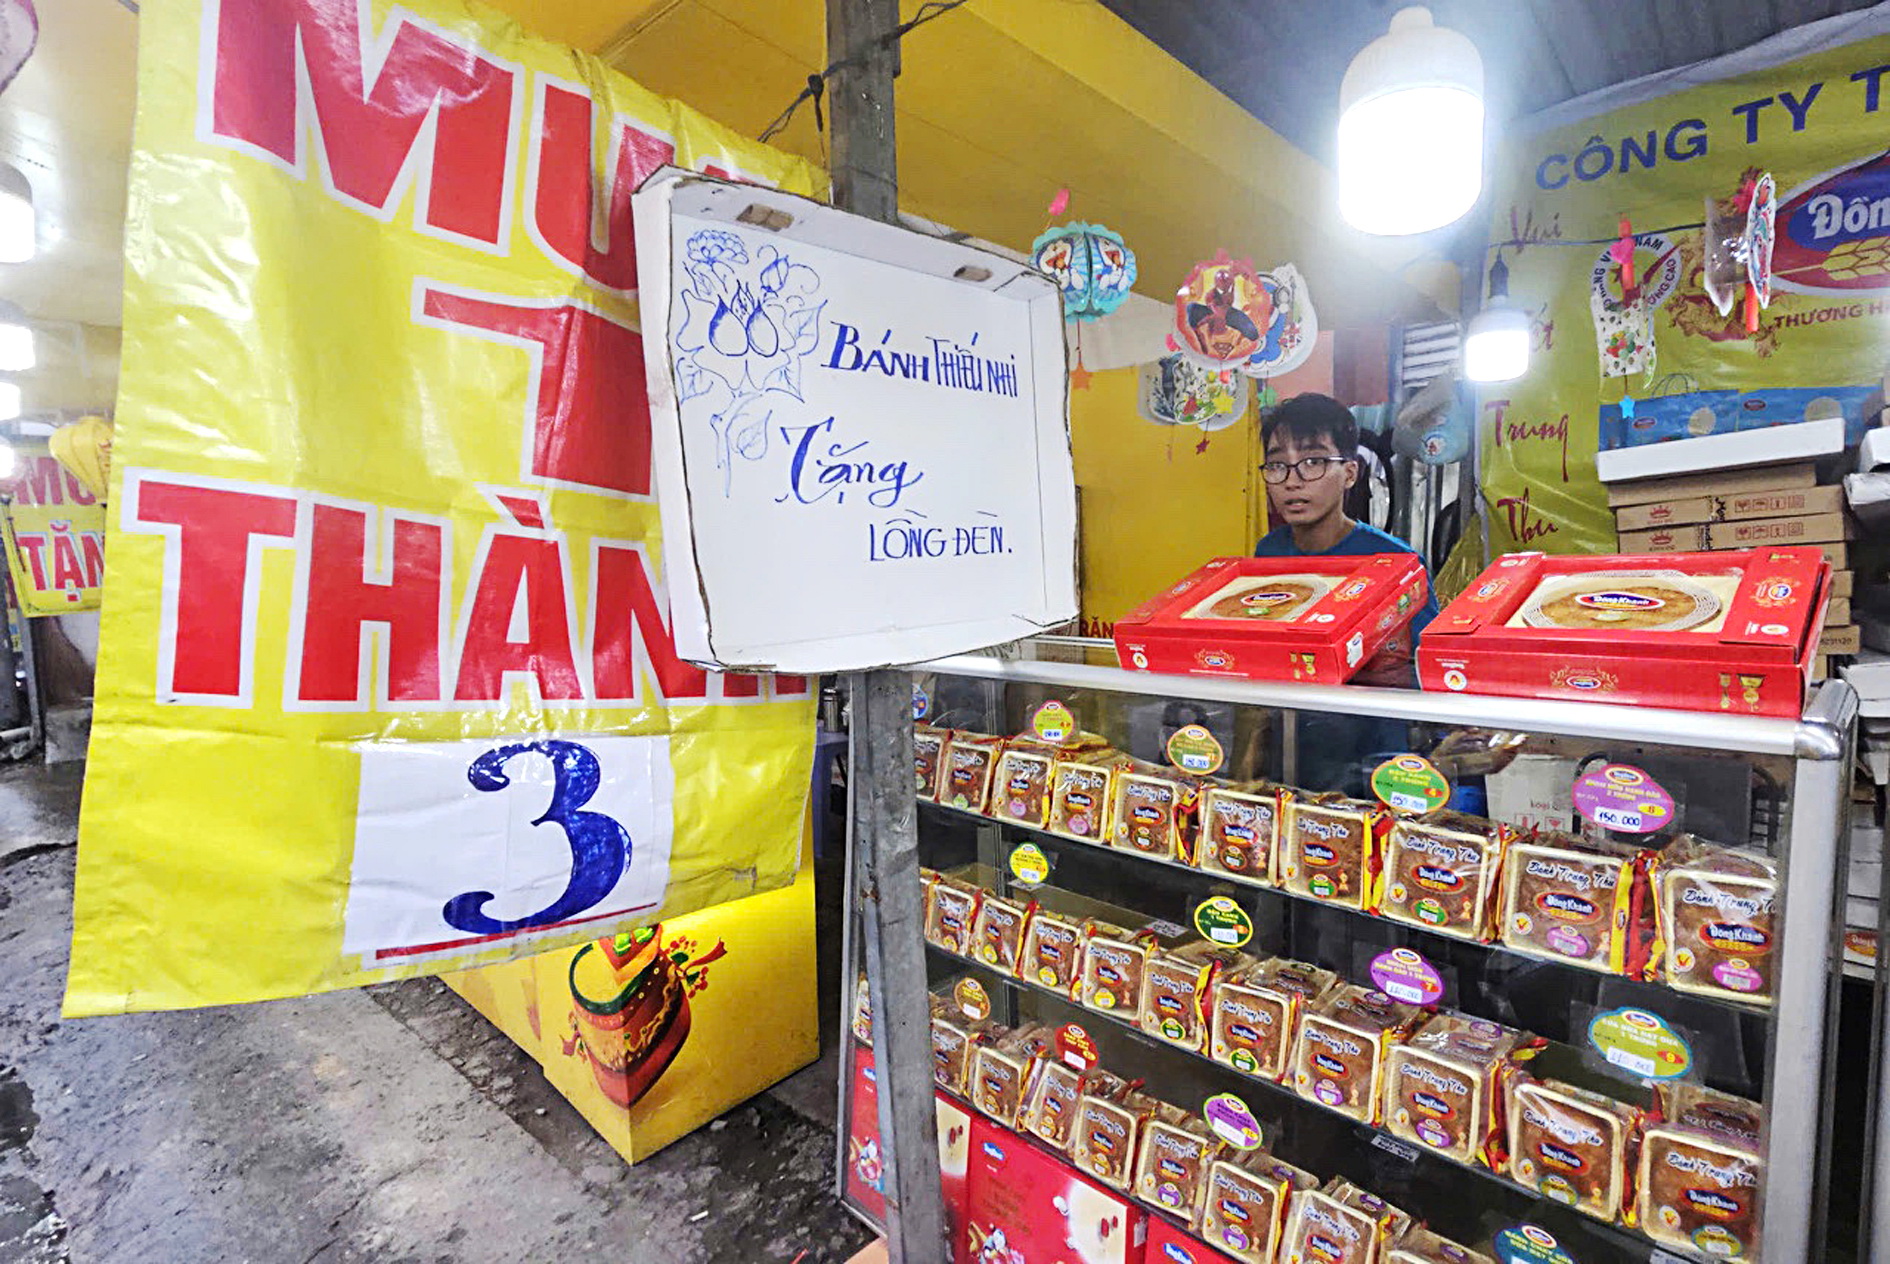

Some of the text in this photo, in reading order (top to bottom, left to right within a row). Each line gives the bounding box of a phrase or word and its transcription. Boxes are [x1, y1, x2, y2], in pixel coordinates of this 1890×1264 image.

[205, 0, 757, 292] MU
[1535, 119, 1708, 190] CÔNG
[1732, 83, 1824, 144] TY
[821, 321, 929, 382] BÁNH
[1774, 304, 1864, 329] THƯƠNG
[776, 417, 924, 508] Tặng
[1485, 400, 1570, 482] Trung
[869, 508, 947, 562] LỒNG
[1497, 488, 1559, 545] Thu
[132, 475, 808, 704] THÀN
[443, 739, 631, 935] 3
